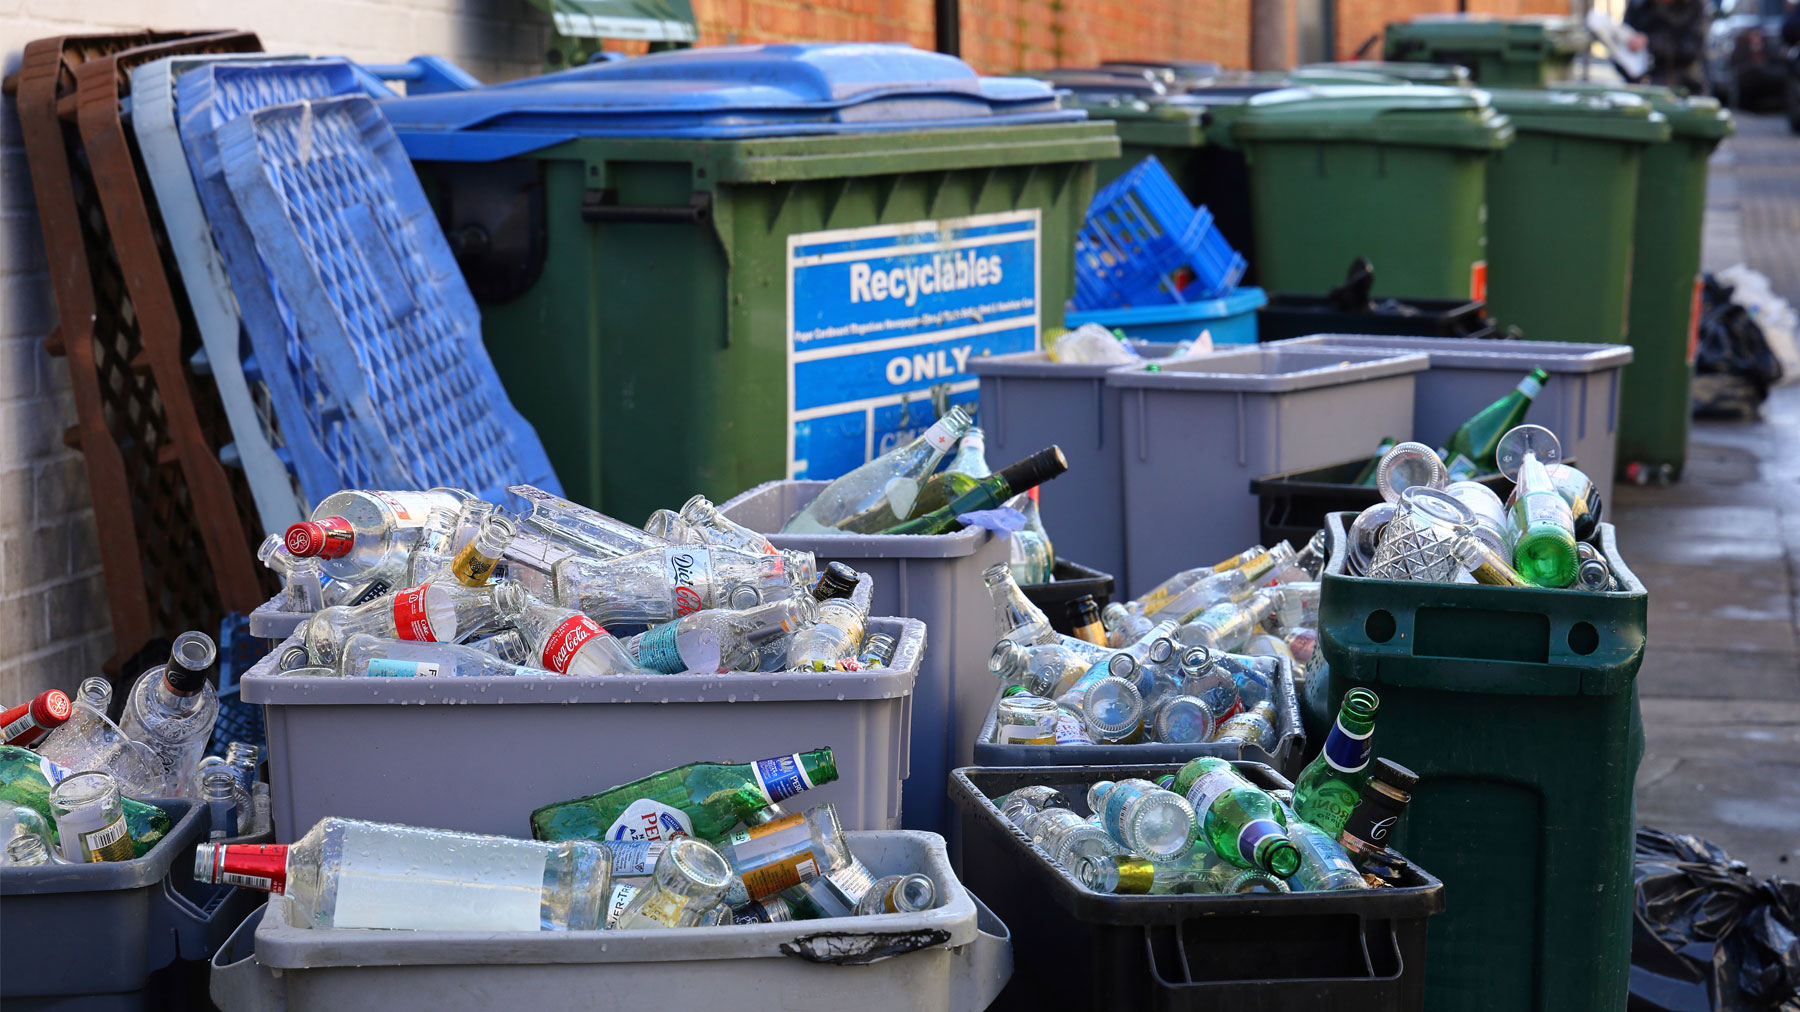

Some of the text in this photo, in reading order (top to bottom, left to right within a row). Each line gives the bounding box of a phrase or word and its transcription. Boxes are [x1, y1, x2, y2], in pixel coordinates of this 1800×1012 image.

[850, 249, 1002, 307] Recyclables
[886, 345, 972, 385] ONLY
[360, 584, 383, 604] ARTIN
[672, 554, 702, 617] Diet Cok
[557, 622, 569, 634] TASTE
[552, 624, 588, 673] Coca-Cola
[790, 775, 804, 789] PERO
